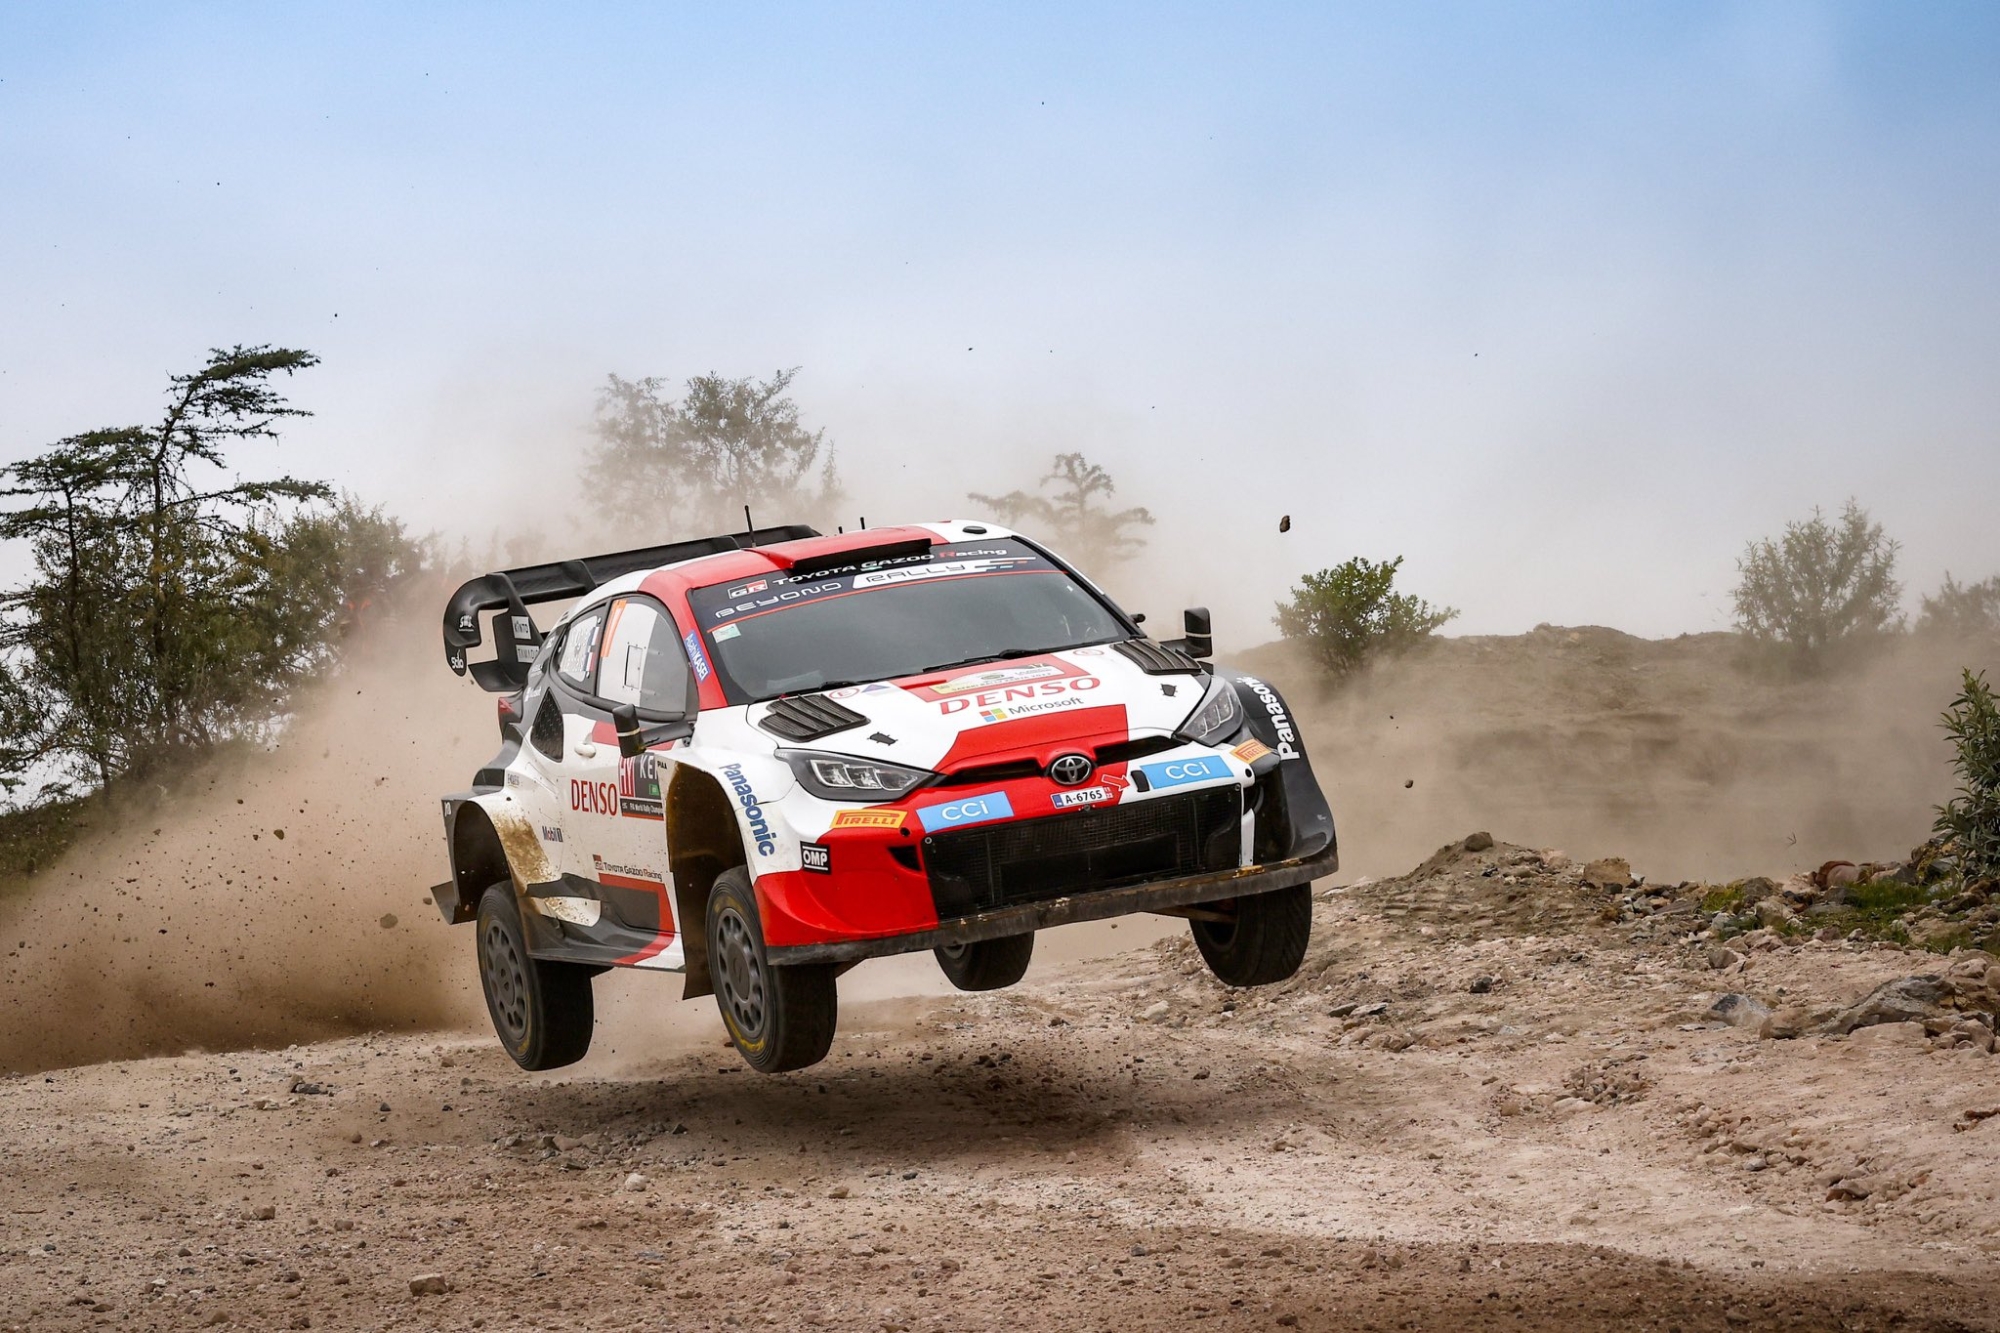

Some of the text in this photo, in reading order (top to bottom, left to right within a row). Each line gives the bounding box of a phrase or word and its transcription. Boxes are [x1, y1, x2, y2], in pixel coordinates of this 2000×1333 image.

[715, 564, 966, 619] BEYOND RALLY
[730, 549, 1008, 598] GR TOYOTA GAZOO Racing
[939, 677, 1101, 715] DENSO
[1008, 696, 1084, 716] Microsoft
[571, 779, 618, 816] DENSO
[719, 762, 776, 857] Panasonic
[1065, 789, 1103, 804] A-6765
[836, 812, 901, 825] PIRELLI
[803, 850, 828, 866] OMP
